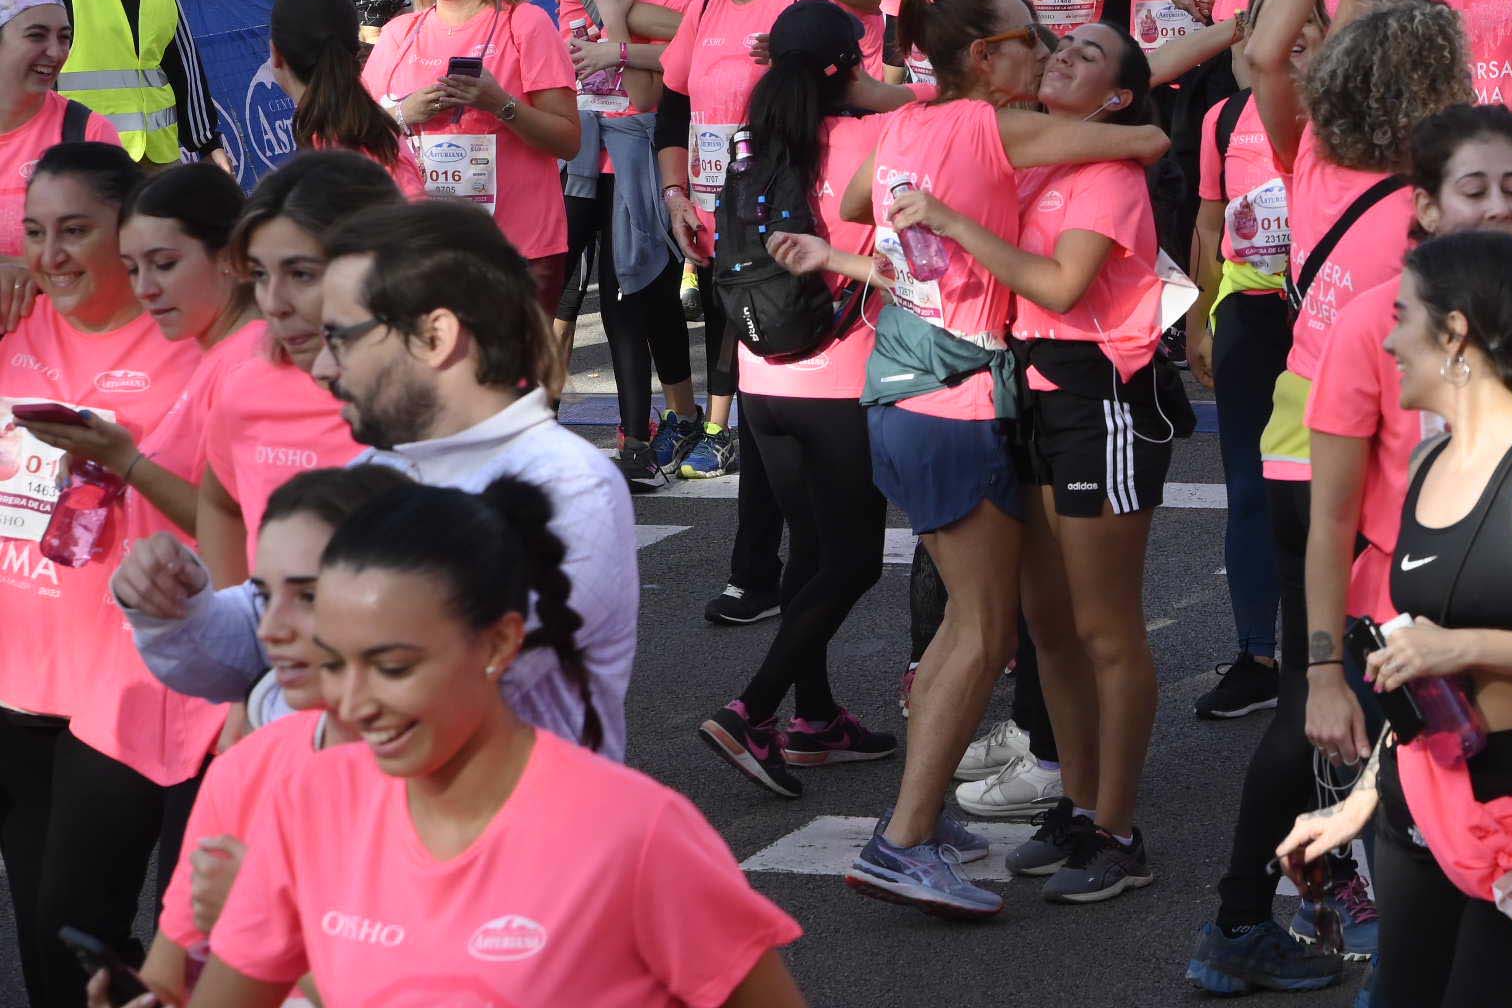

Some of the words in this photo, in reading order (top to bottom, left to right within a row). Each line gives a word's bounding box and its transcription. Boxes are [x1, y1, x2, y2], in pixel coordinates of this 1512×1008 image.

[1160, 26, 1186, 37] 016
[701, 159, 722, 171] 016
[429, 170, 462, 182] 016
[25, 454, 58, 476] 01
[1067, 481, 1098, 491] adidas
[0, 542, 59, 585] MA
